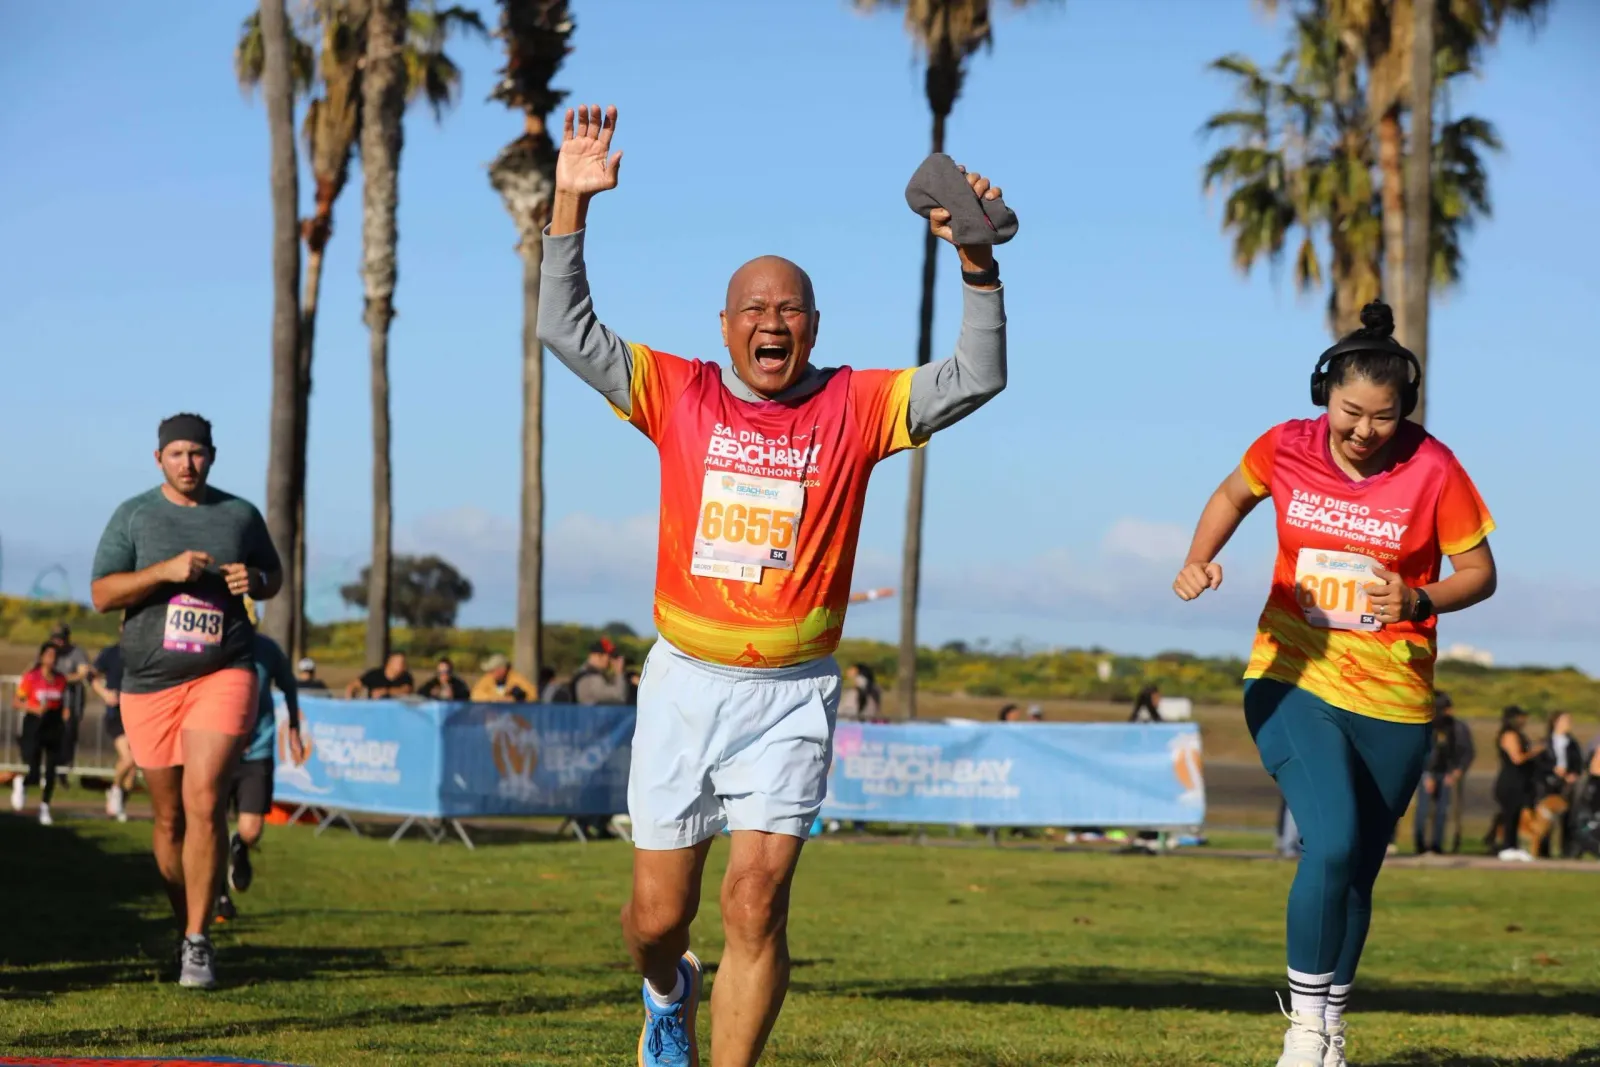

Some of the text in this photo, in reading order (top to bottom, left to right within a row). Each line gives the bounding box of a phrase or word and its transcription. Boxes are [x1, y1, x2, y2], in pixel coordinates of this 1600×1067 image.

[713, 423, 736, 438] SA
[705, 456, 732, 467] HALF
[1292, 489, 1370, 516] SAN DIEGO
[702, 501, 794, 549] 6655
[1286, 517, 1309, 528] HALF
[1310, 523, 1366, 542] MARATHON
[1287, 500, 1408, 541] BEACH&BAY
[773, 551, 784, 559] 5K
[1344, 544, 1365, 554] April
[1378, 552, 1399, 561] 2024
[169, 610, 221, 635] 4943
